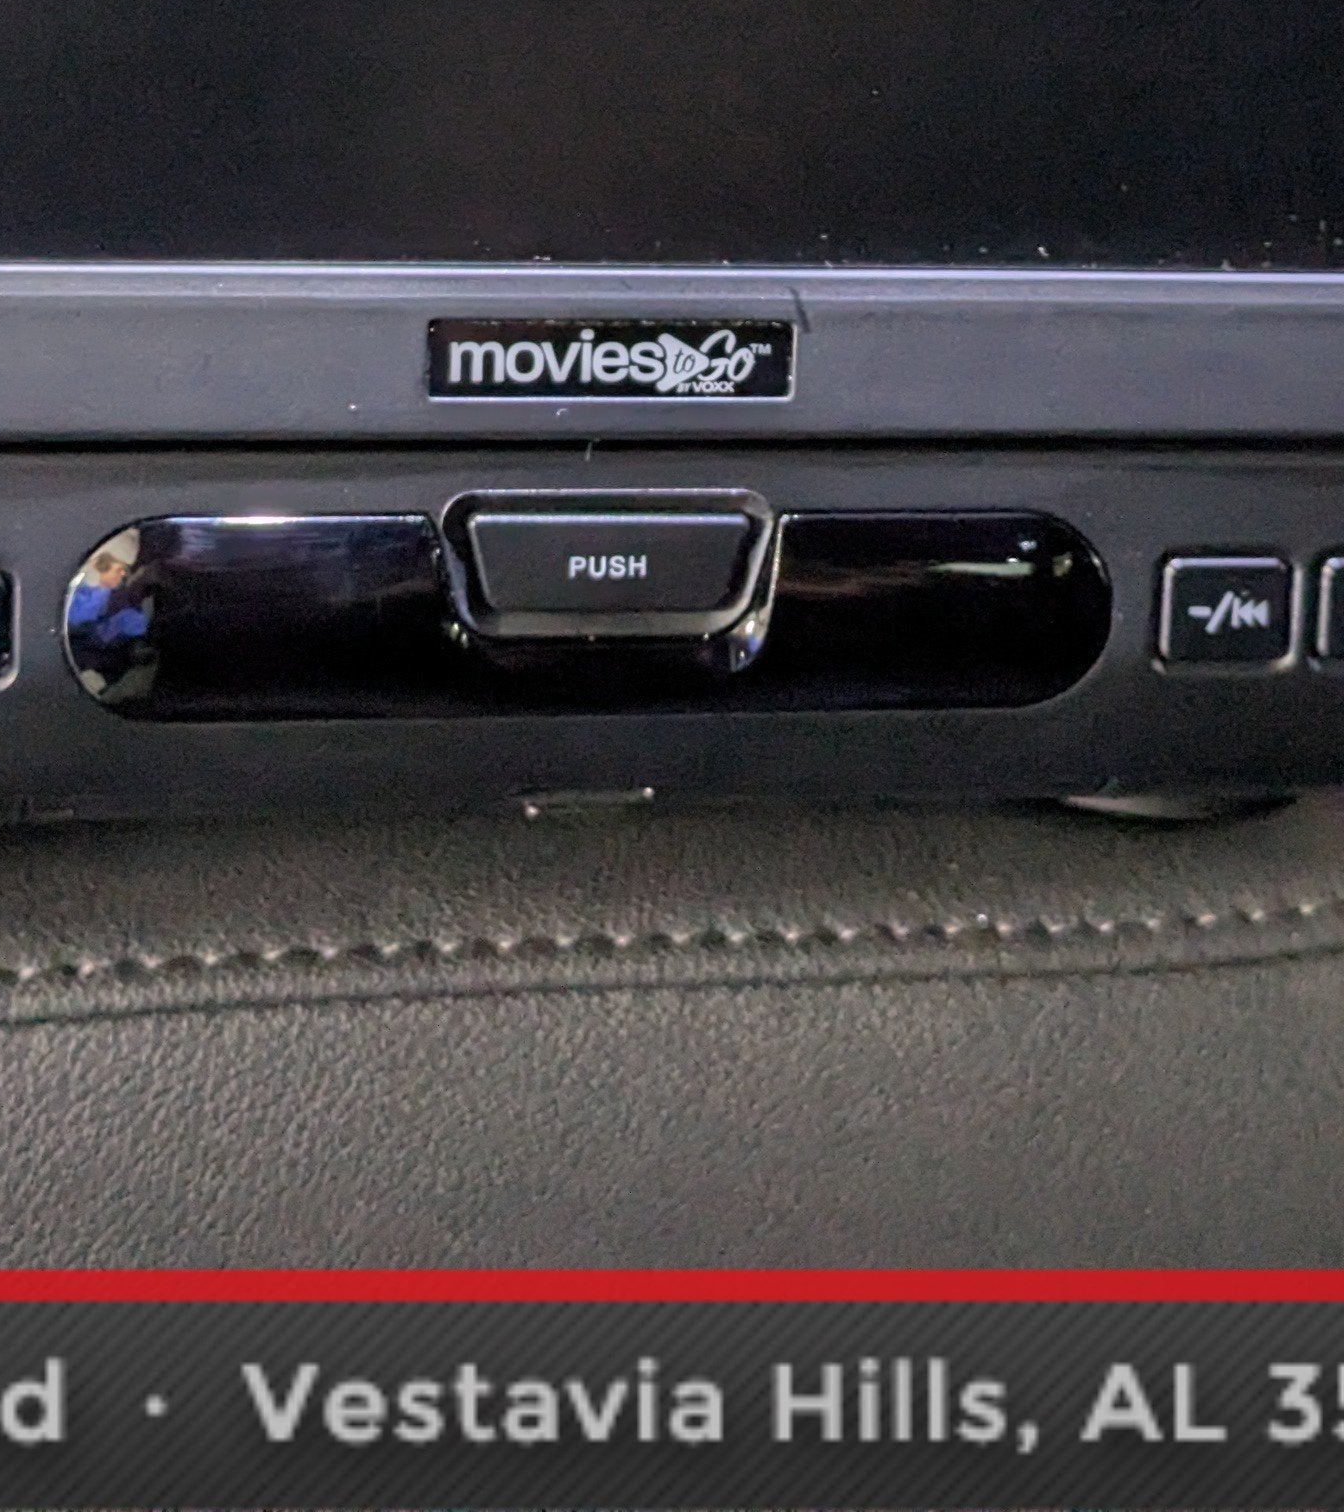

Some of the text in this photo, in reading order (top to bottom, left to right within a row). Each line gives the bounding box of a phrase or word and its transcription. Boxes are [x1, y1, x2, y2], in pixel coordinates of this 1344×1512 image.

[448, 328, 666, 383] movies
[672, 347, 696, 375] to
[567, 554, 649, 581] PUSH
